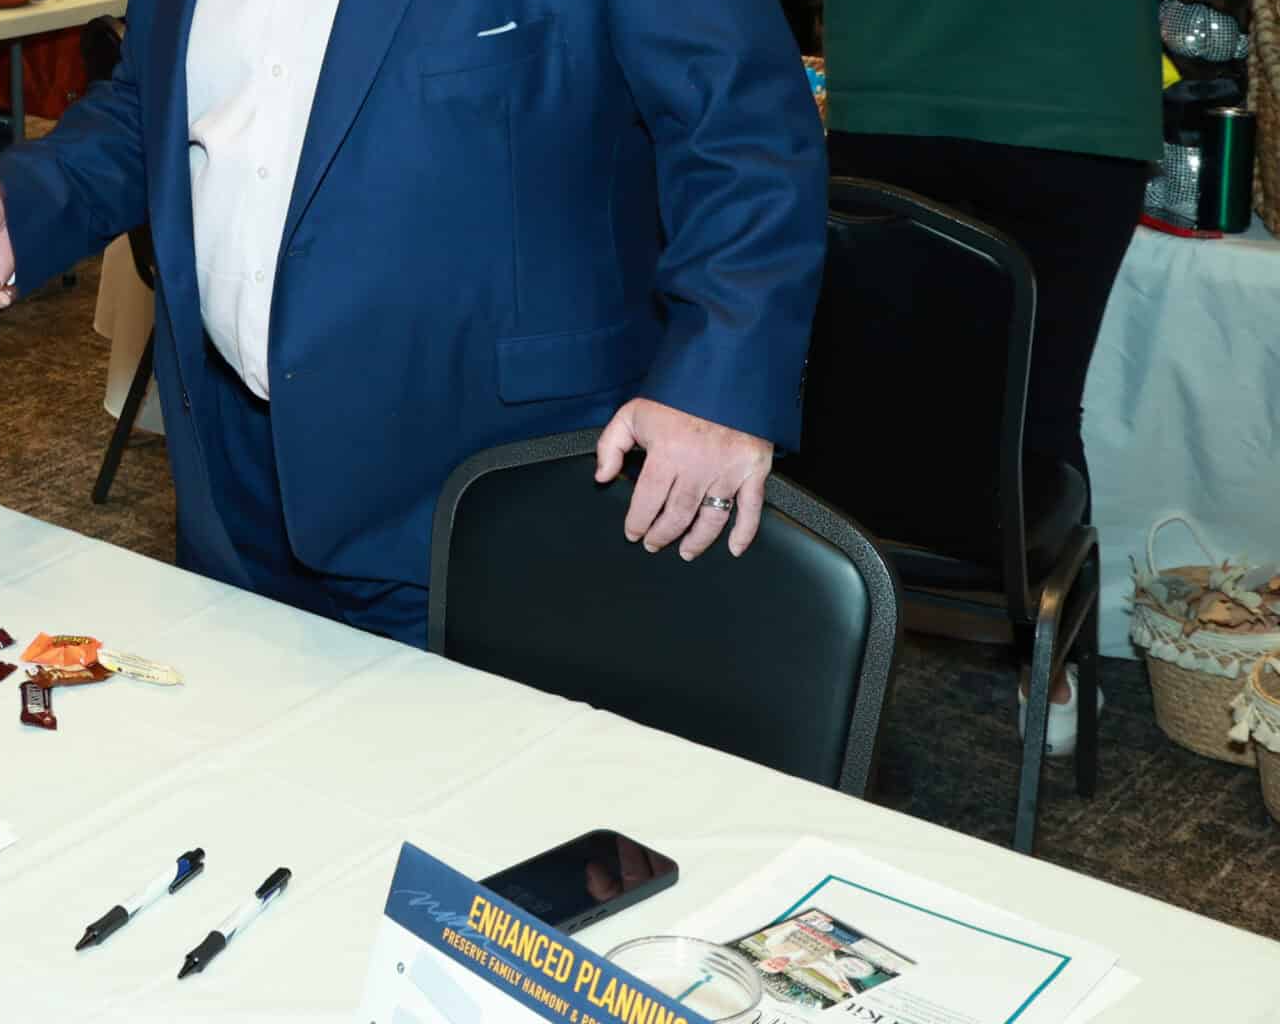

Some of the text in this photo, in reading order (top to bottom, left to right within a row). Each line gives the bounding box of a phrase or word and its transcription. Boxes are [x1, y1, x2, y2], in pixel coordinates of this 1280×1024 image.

[441, 927, 579, 1022] PRESERVE FAMILY HARMONY &
[467, 895, 575, 984] ENHANCED
